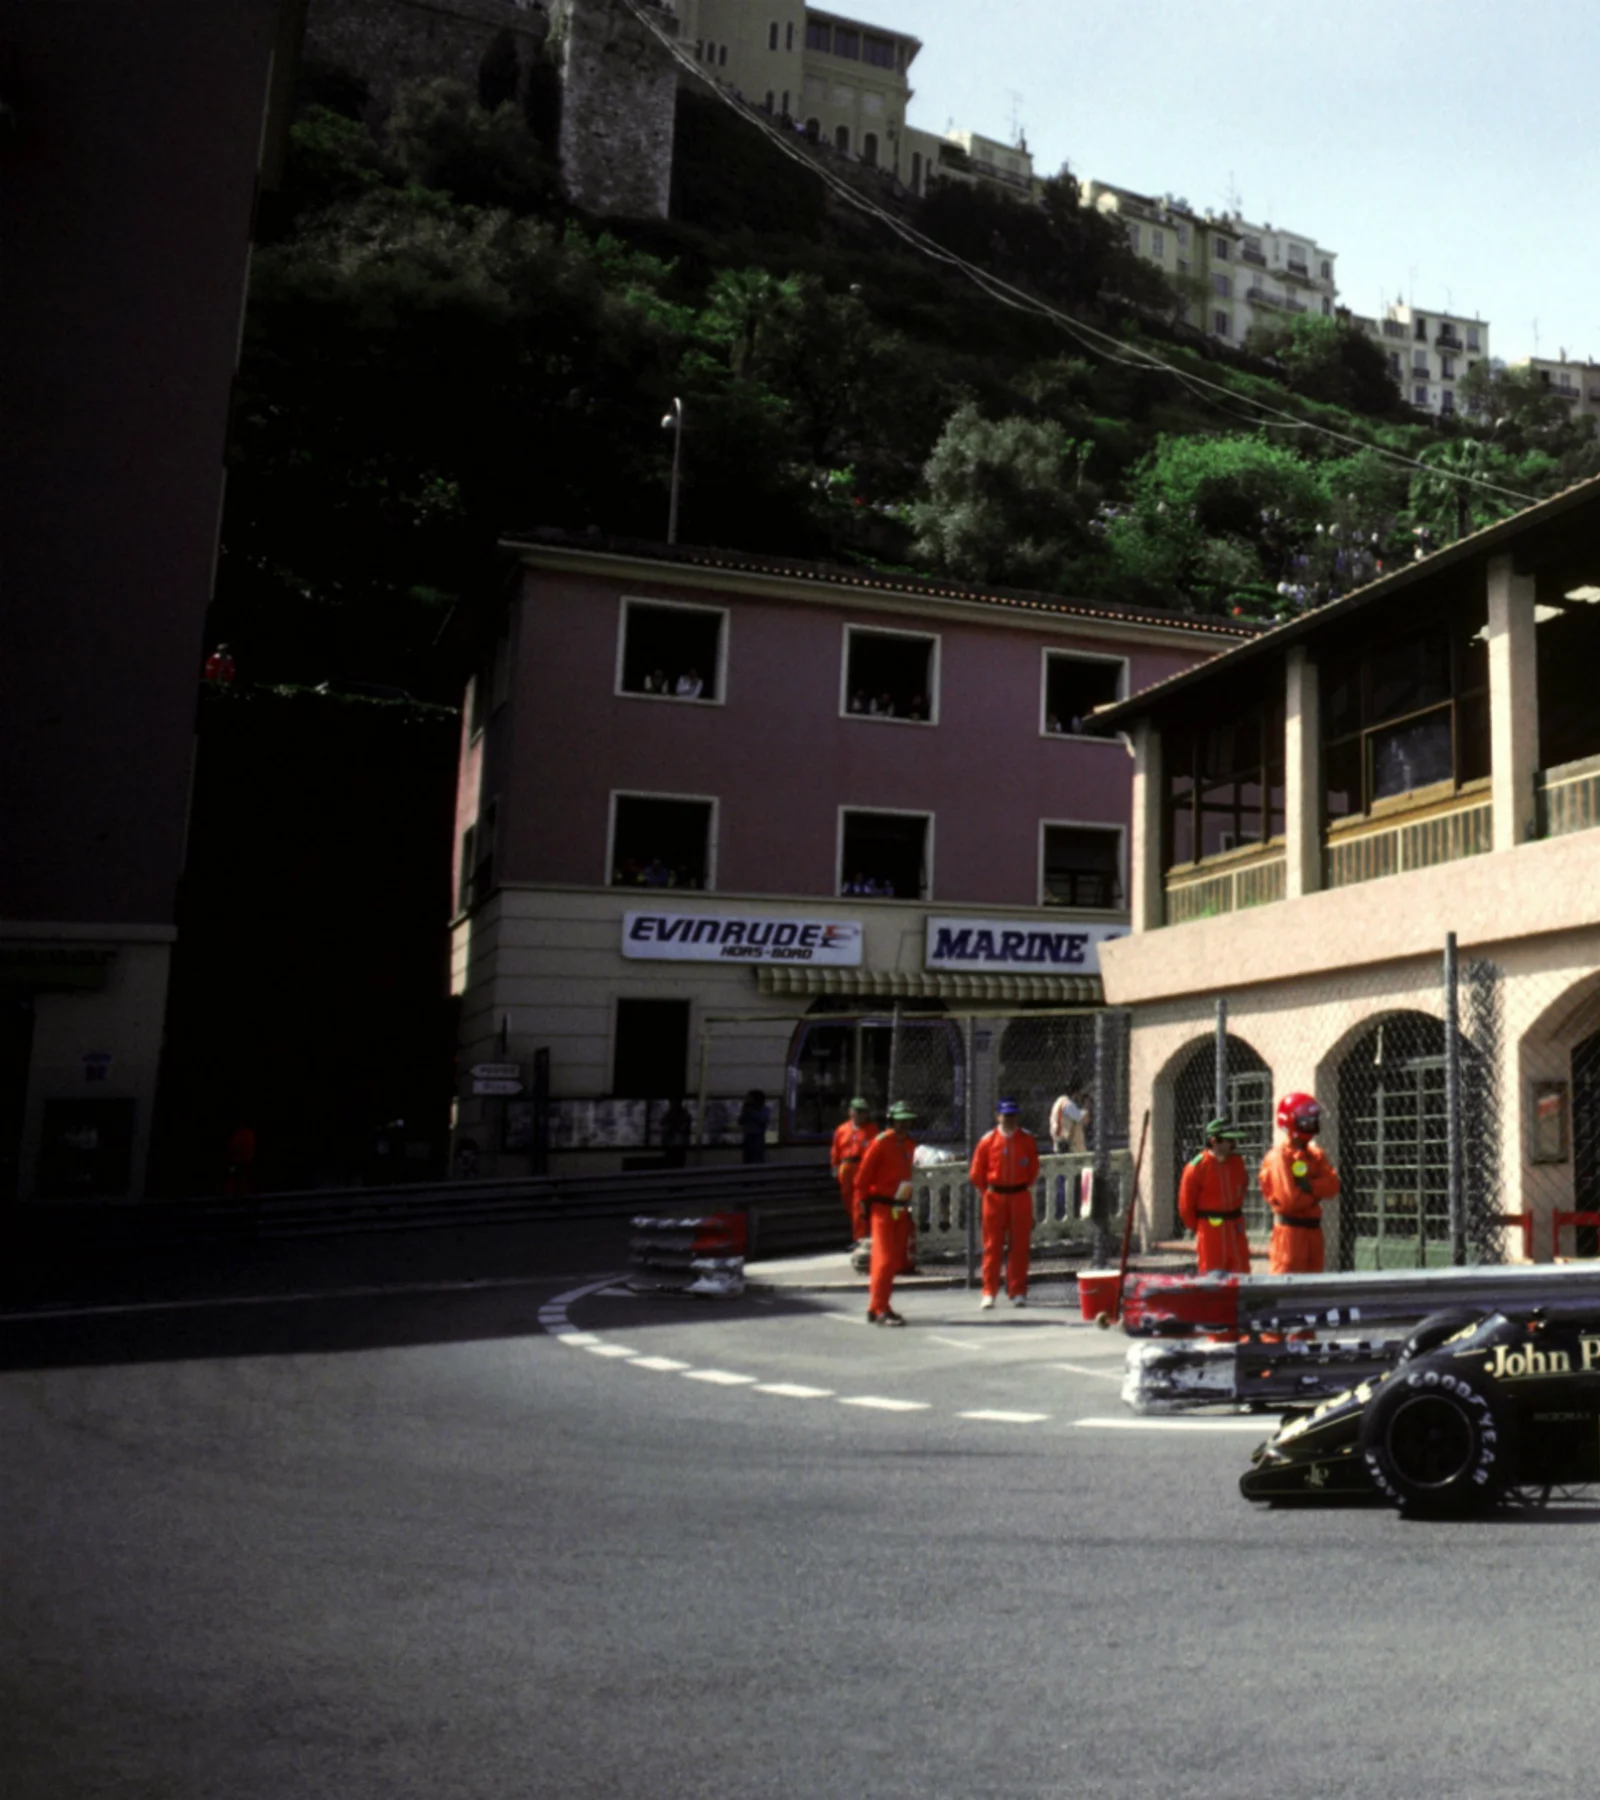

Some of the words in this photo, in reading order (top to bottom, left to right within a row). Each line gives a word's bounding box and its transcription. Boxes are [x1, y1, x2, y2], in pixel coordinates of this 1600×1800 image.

[628, 916, 822, 948] EVINRUDE
[931, 927, 1088, 964] MARINE
[719, 944, 813, 960] HORS-BORD
[1493, 1342, 1572, 1378] John
[1406, 1371, 1497, 1485] GOODYEAR
